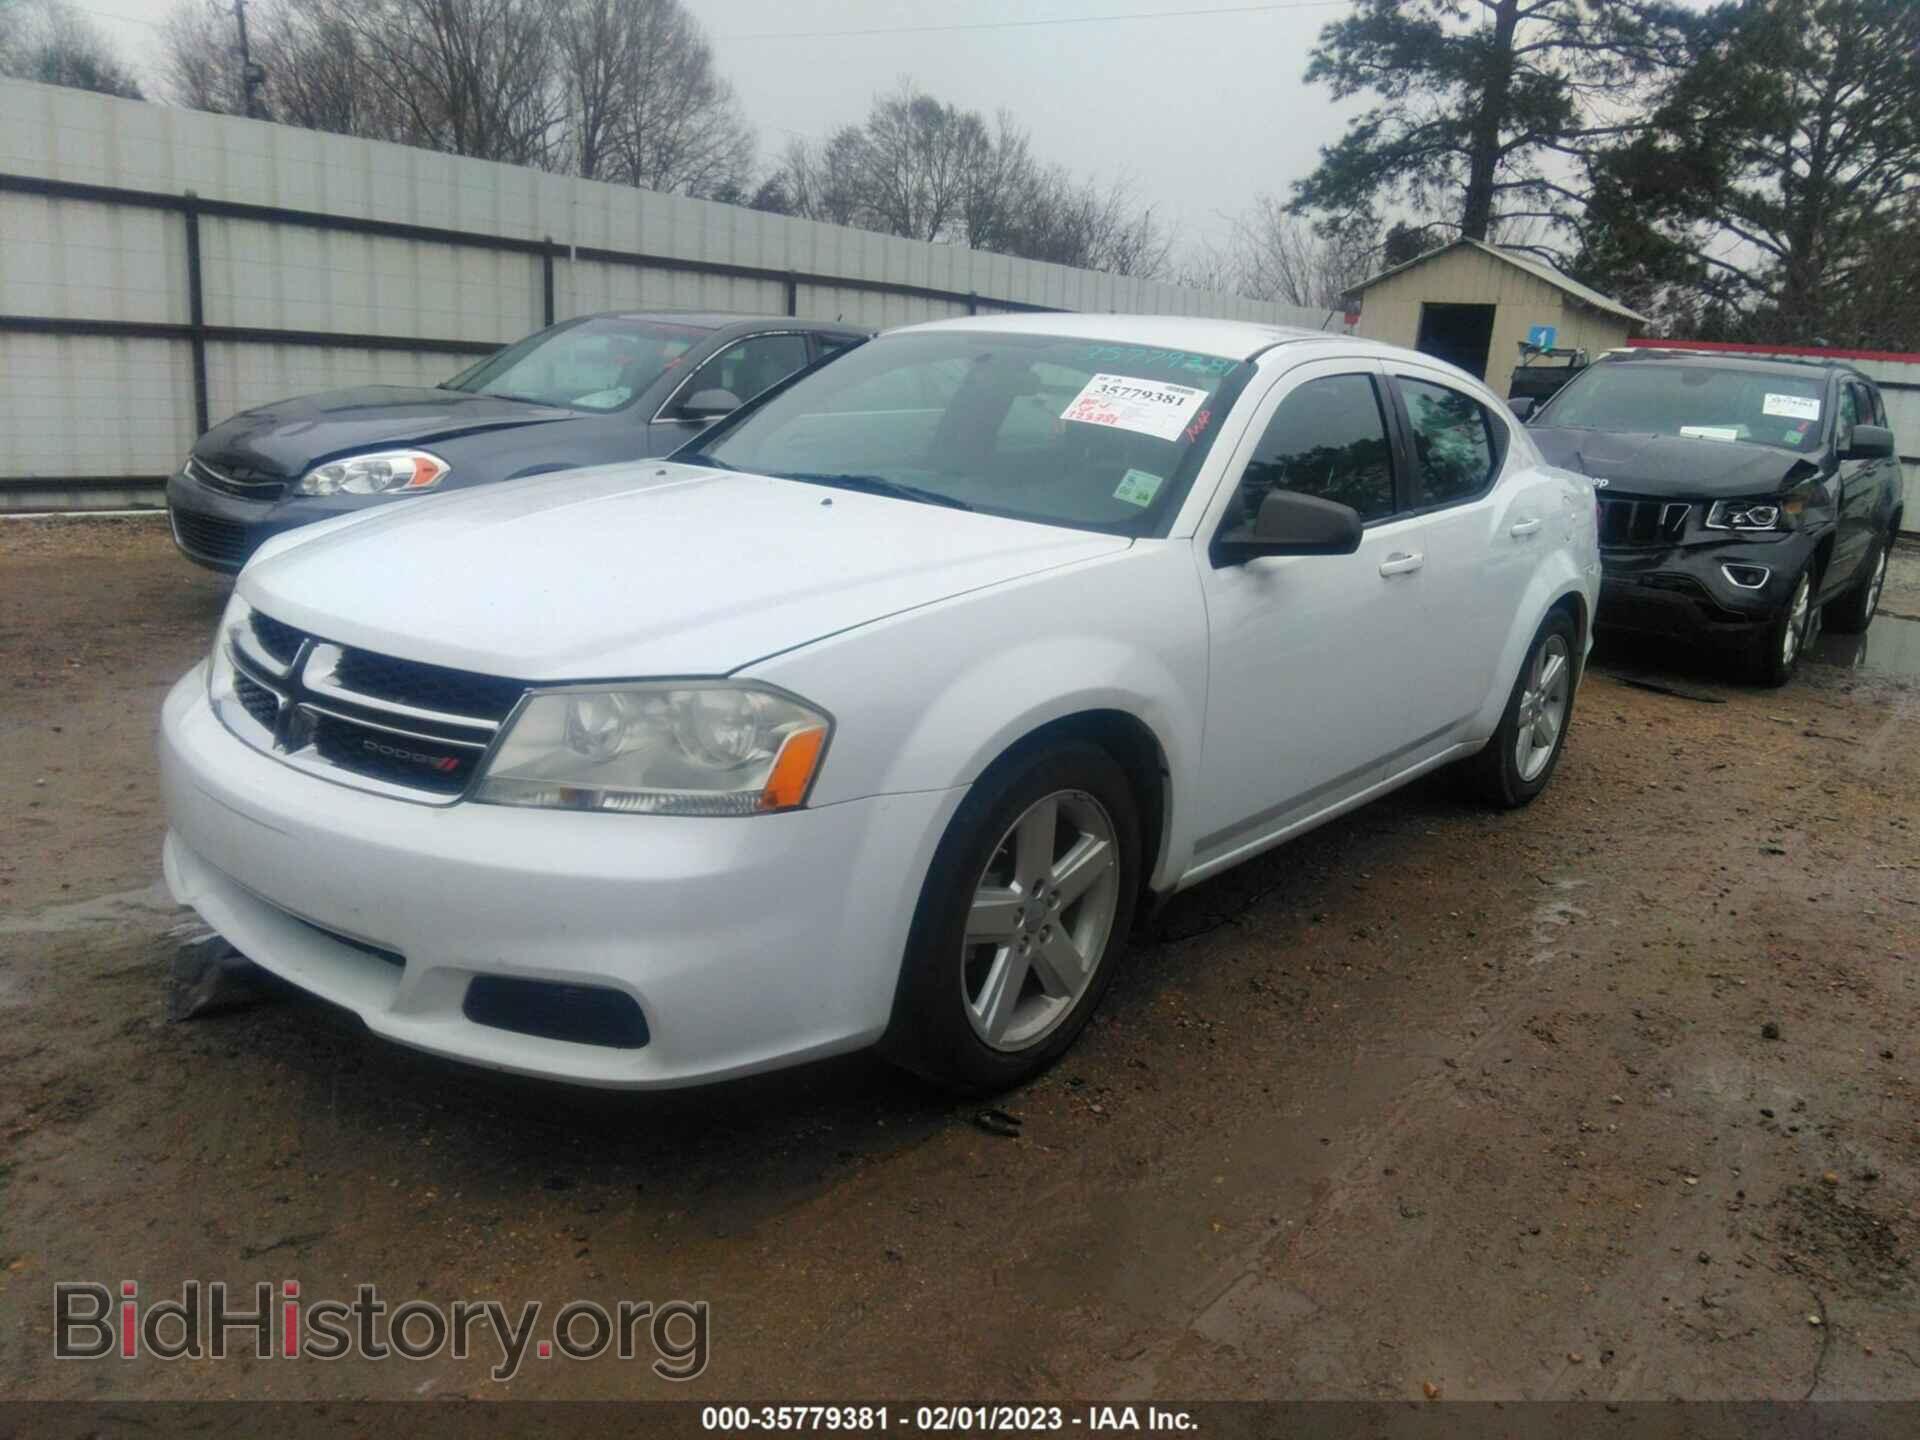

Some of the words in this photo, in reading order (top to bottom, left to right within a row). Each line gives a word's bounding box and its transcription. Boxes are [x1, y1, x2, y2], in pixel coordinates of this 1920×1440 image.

[1094, 384, 1185, 407] 35779381
[1592, 478, 1609, 488] ep
[363, 740, 439, 764] DODGE
